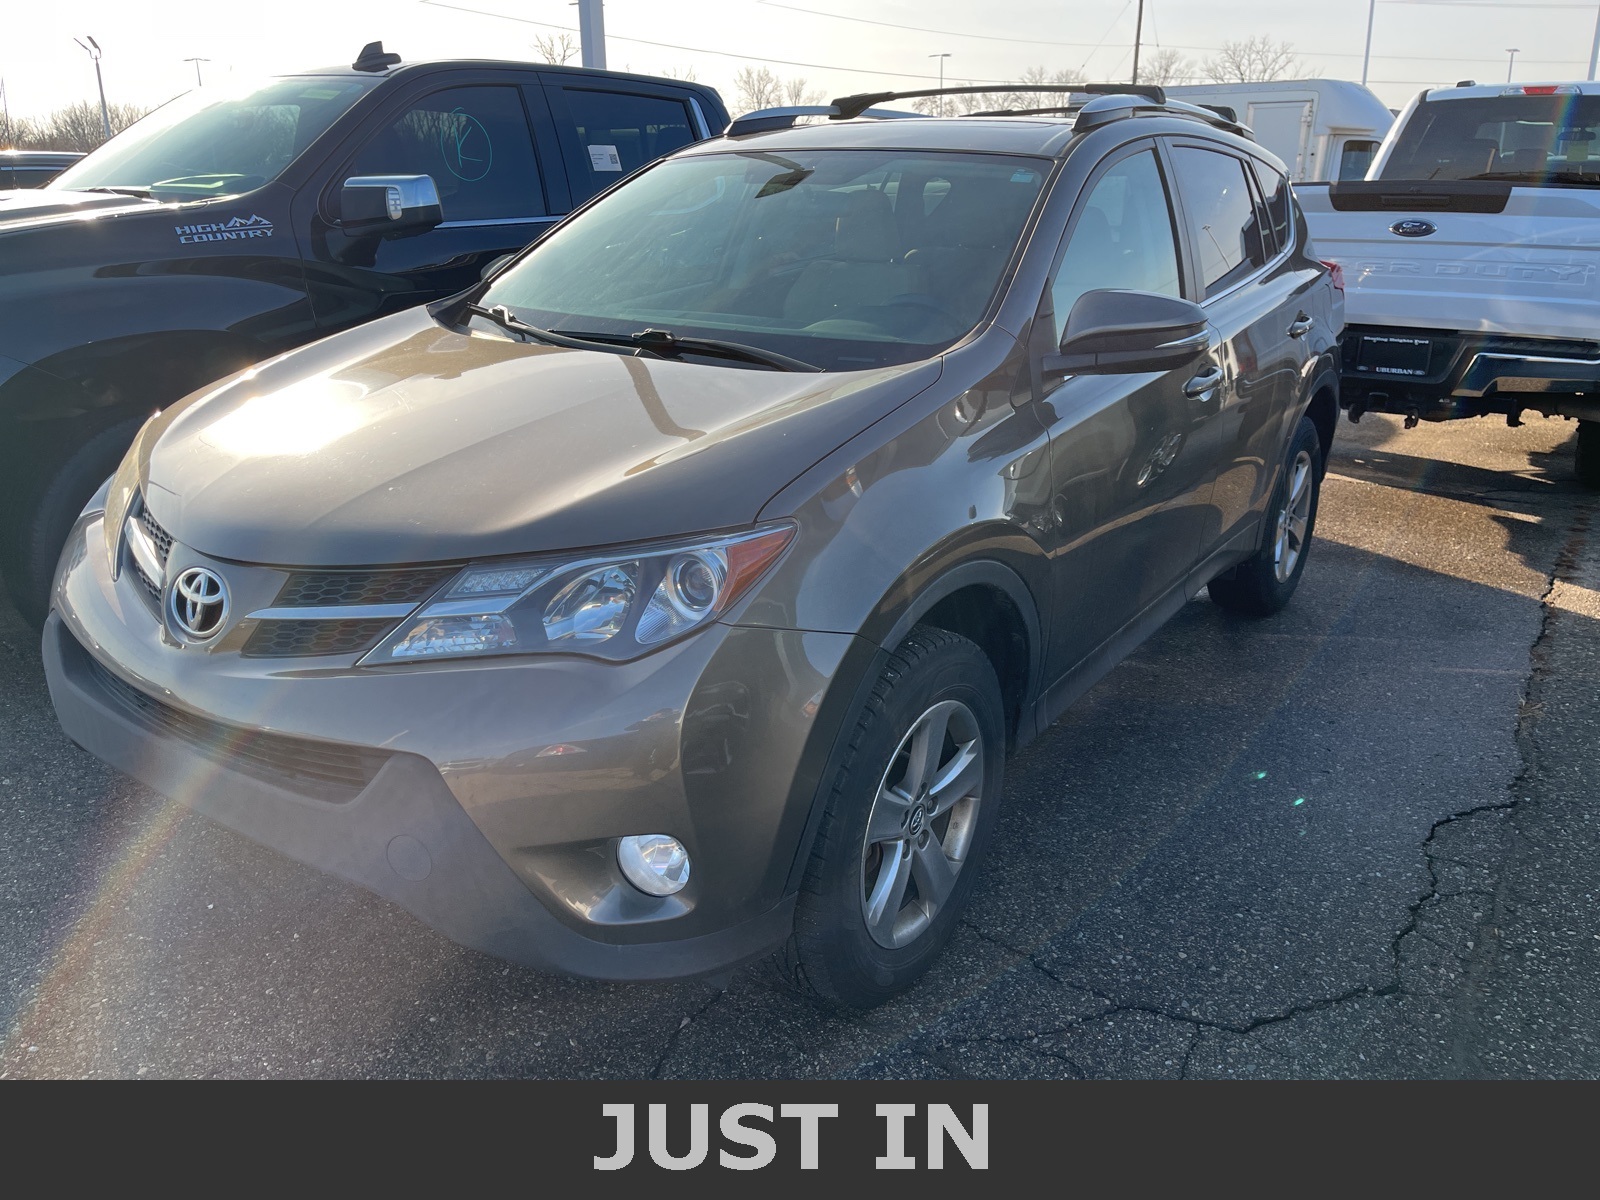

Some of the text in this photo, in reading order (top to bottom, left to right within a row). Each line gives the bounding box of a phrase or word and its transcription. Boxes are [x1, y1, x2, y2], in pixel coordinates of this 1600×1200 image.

[174, 222, 226, 235] HIGH
[179, 228, 274, 244] COUNTRY
[1435, 262, 1582, 280] DUTY
